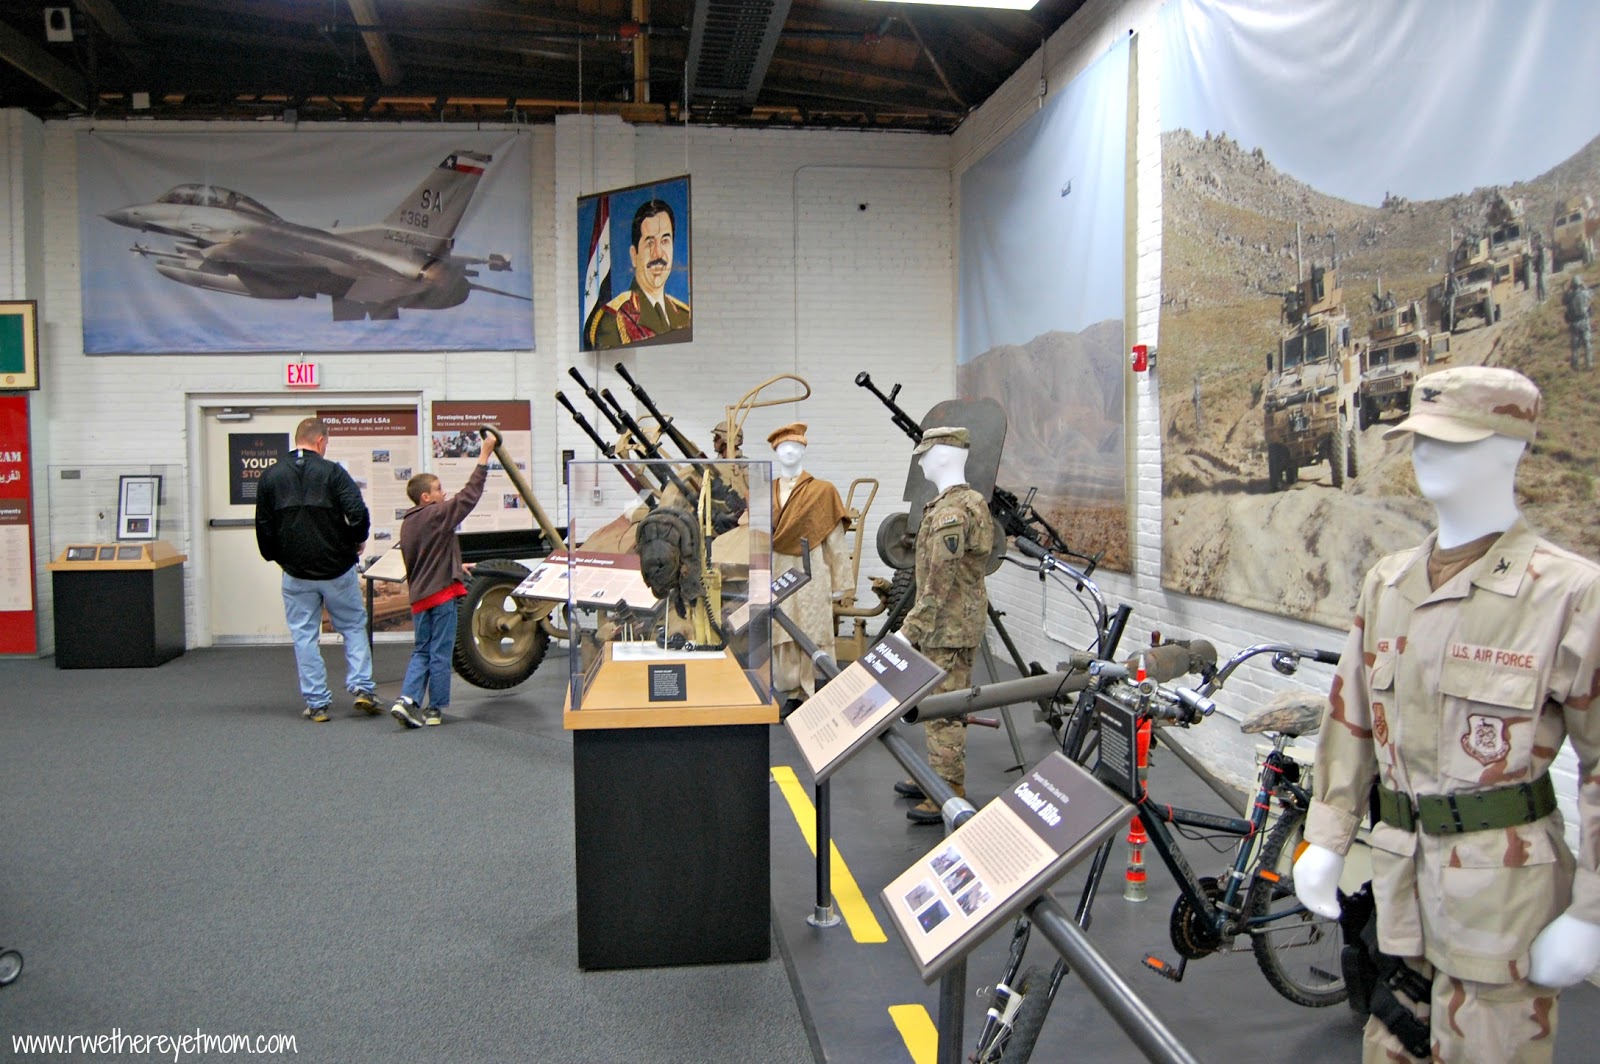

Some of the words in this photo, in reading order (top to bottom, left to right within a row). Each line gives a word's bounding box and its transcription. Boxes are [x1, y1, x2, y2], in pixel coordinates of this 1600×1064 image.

[421, 189, 443, 213] SA
[407, 211, 429, 228] 368
[287, 364, 315, 384] EXIT
[1452, 644, 1470, 660] U.S.
[1474, 648, 1493, 662] AIR
[1496, 651, 1534, 669] FORCE
[1014, 782, 1048, 813] Combat
[1038, 802, 1062, 827] Bike
